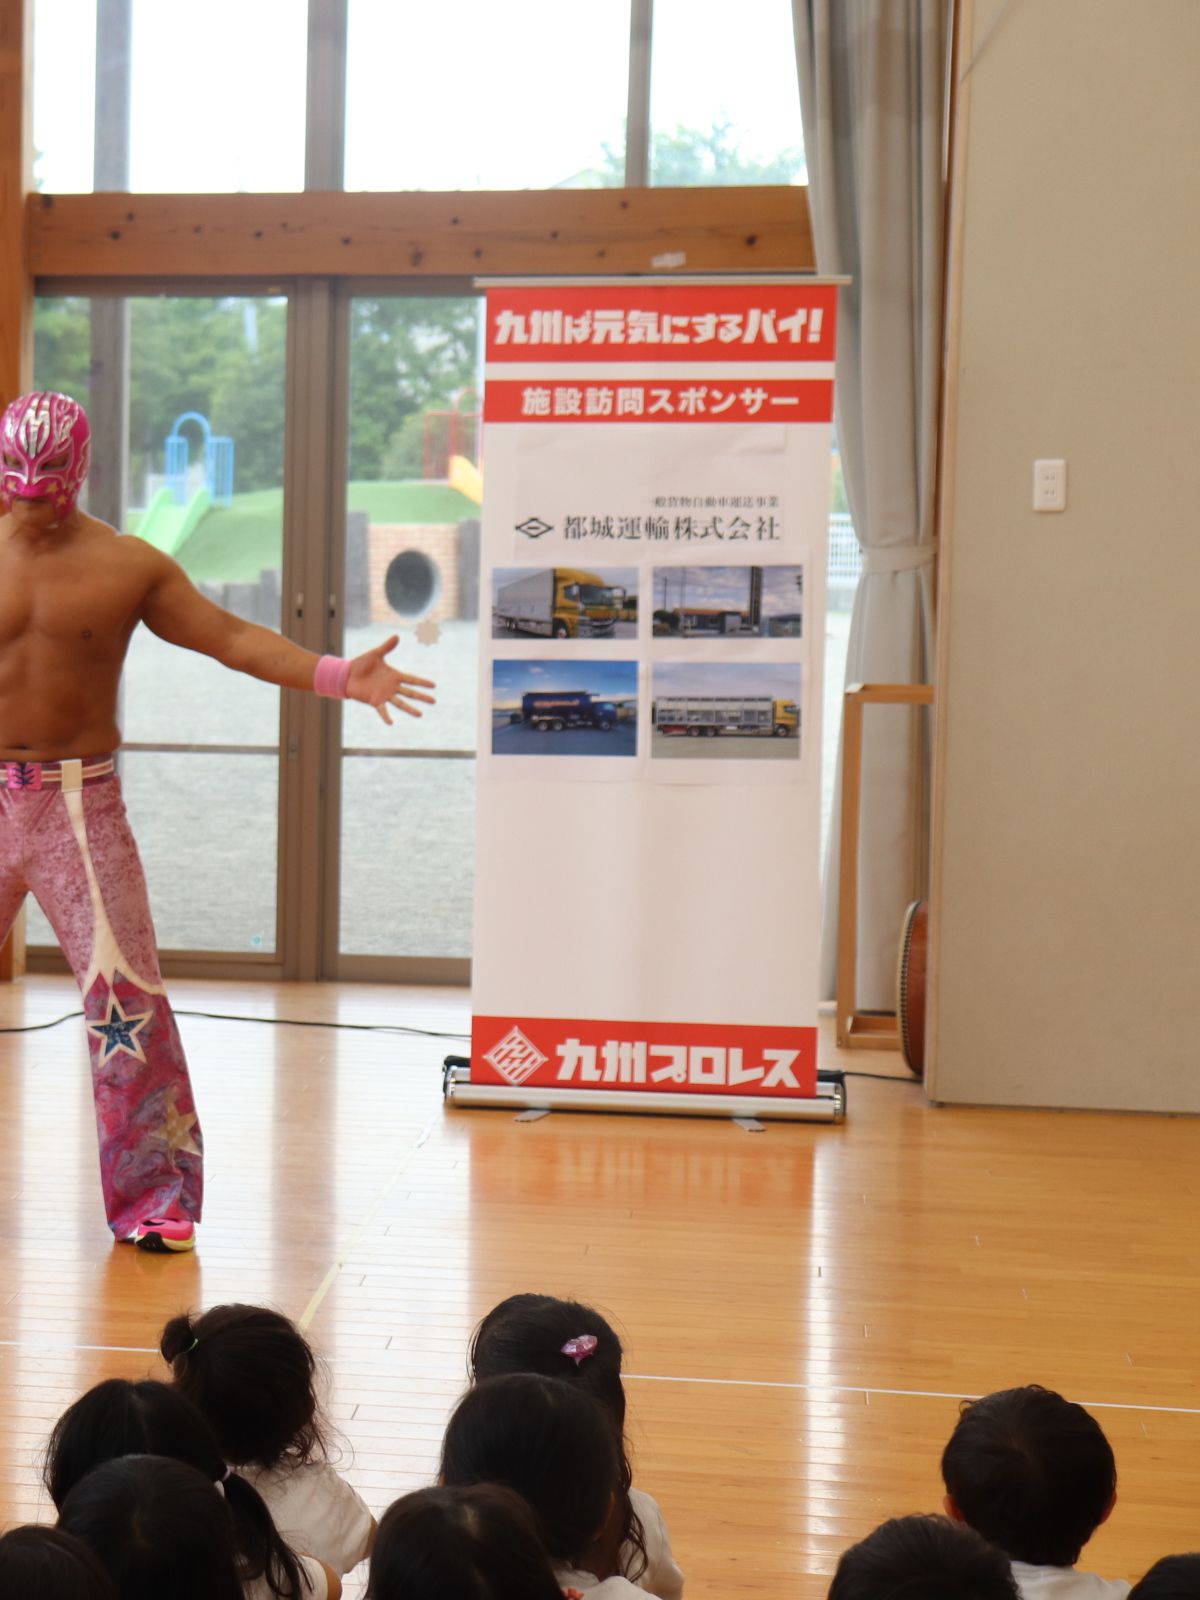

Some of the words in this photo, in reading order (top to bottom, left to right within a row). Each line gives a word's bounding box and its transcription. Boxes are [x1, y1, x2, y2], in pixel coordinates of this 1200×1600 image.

[521, 387, 800, 415] 施設訪問スポンサー
[562, 515, 781, 542] 都城運輸株式会社
[556, 1038, 801, 1088] 九州プロレス
